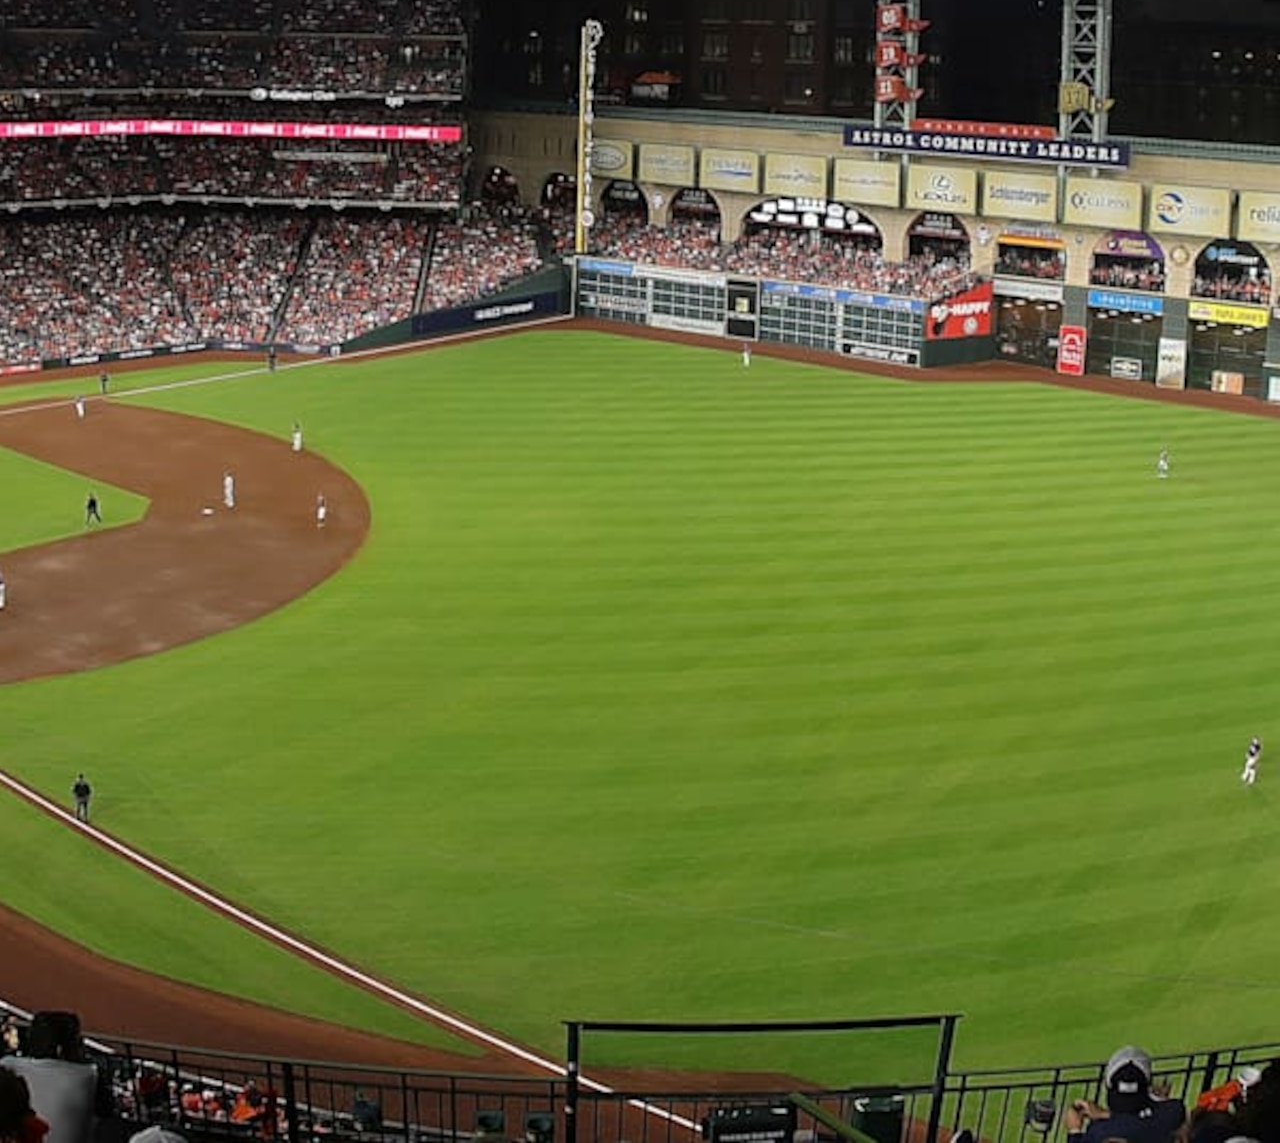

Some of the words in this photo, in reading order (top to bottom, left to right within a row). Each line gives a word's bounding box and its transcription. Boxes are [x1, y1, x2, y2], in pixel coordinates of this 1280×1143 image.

[852, 130, 915, 146] ASTROS
[920, 134, 1032, 157] COMMUNITY
[1037, 142, 1120, 162] LEADERS
[915, 190, 968, 205] LEXUS
[1156, 202, 1184, 216] OXY
